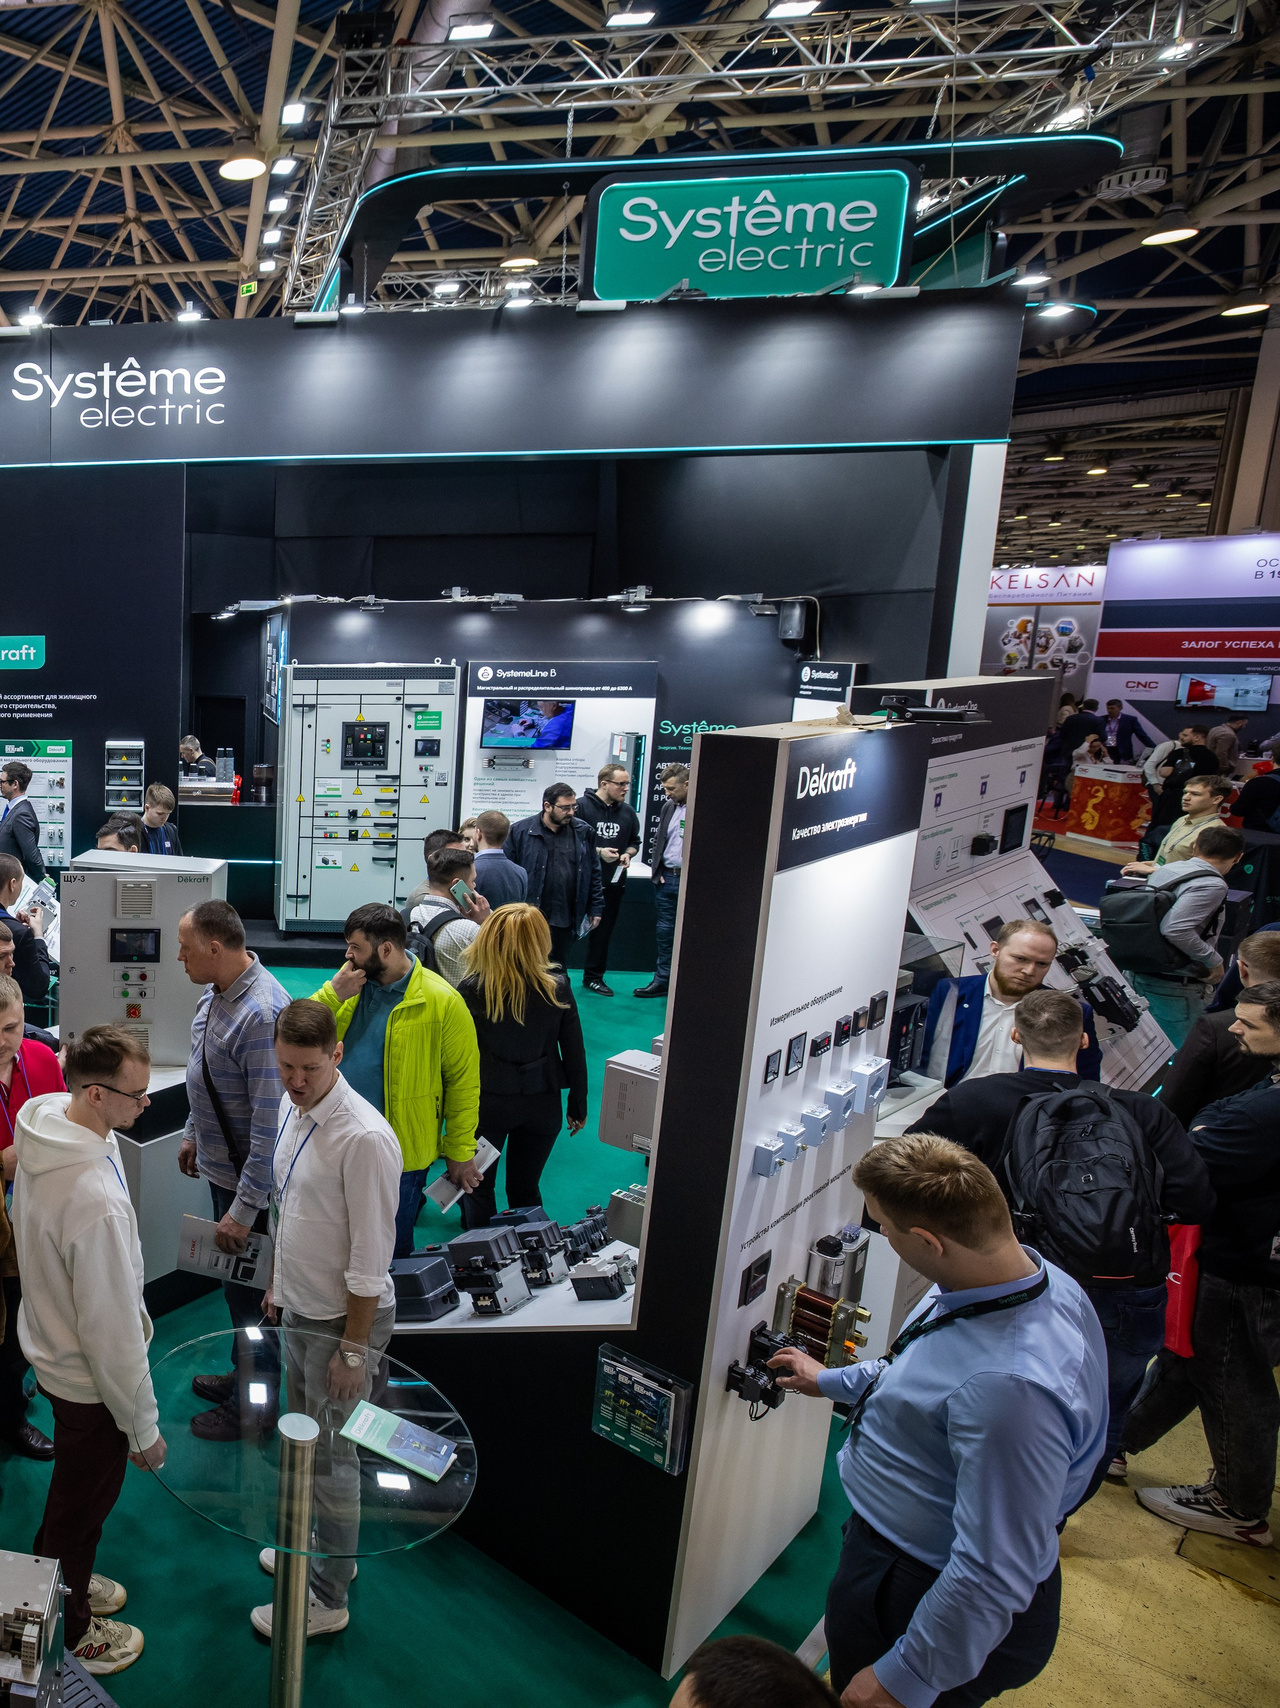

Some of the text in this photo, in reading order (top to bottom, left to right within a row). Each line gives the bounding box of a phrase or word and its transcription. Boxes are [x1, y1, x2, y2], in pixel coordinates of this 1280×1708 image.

[619, 190, 877, 250] Systême
[698, 237, 873, 272] electric
[12, 356, 226, 408] Systême
[80, 398, 225, 428] electric
[1254, 571, 1264, 579] В
[497, 670, 548, 678] SystemeLine
[1125, 681, 1159, 689] CNC
[797, 758, 856, 799] Dēkraft
[792, 825, 821, 840] Качество
[770, 986, 842, 1027] Измерительное оборудование
[740, 1226, 769, 1252] Устройства
